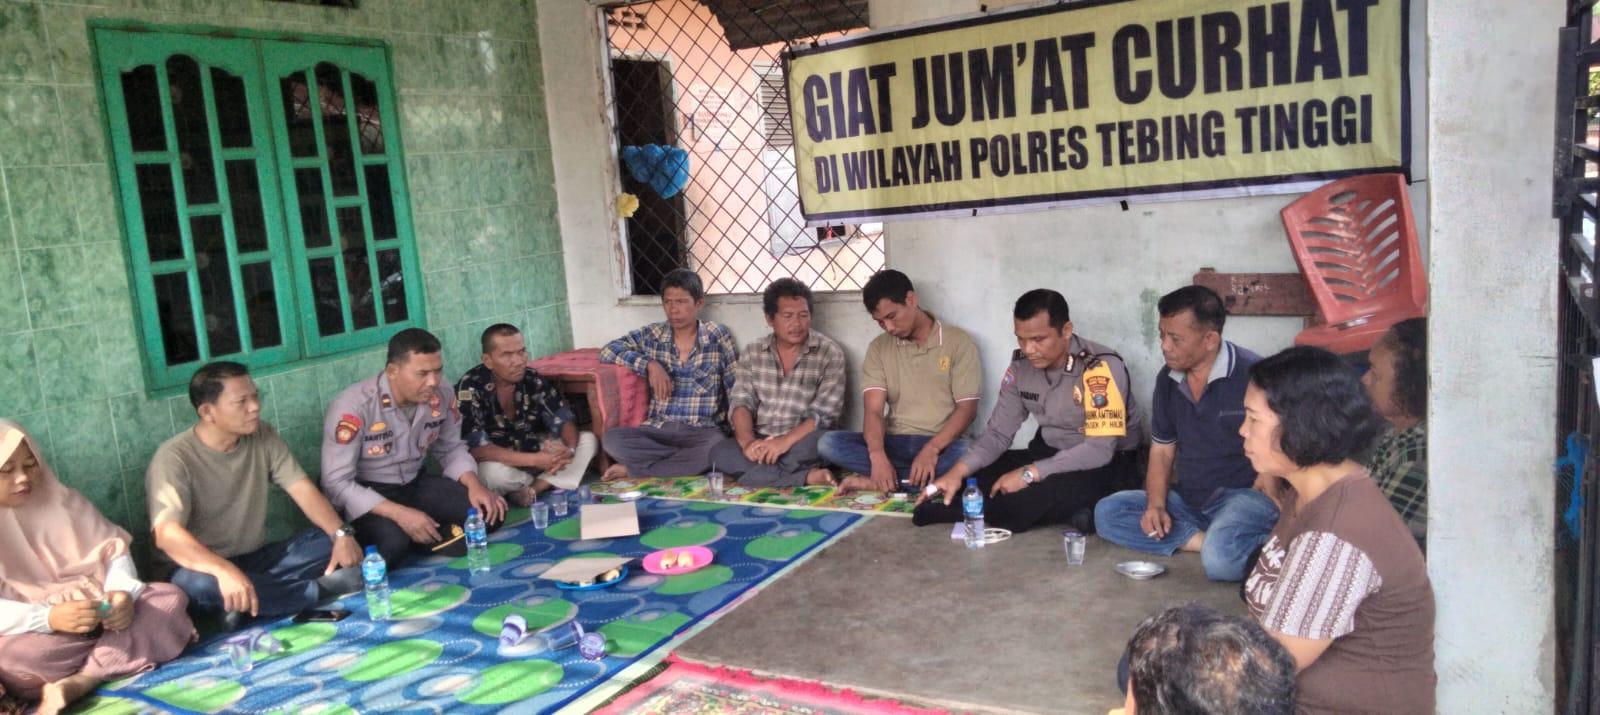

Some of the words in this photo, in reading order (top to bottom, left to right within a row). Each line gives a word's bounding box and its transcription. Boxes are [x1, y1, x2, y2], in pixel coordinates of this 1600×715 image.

[804, 62, 896, 143] GIAT
[912, 32, 1095, 129] JUM'AT
[1112, 0, 1379, 103] CURHAT
[814, 155, 840, 194] DI
[844, 139, 962, 190] WILAYAH
[972, 125, 1088, 178] POLRES
[1096, 112, 1224, 166] TEBING
[1235, 94, 1373, 155] TINGGI
